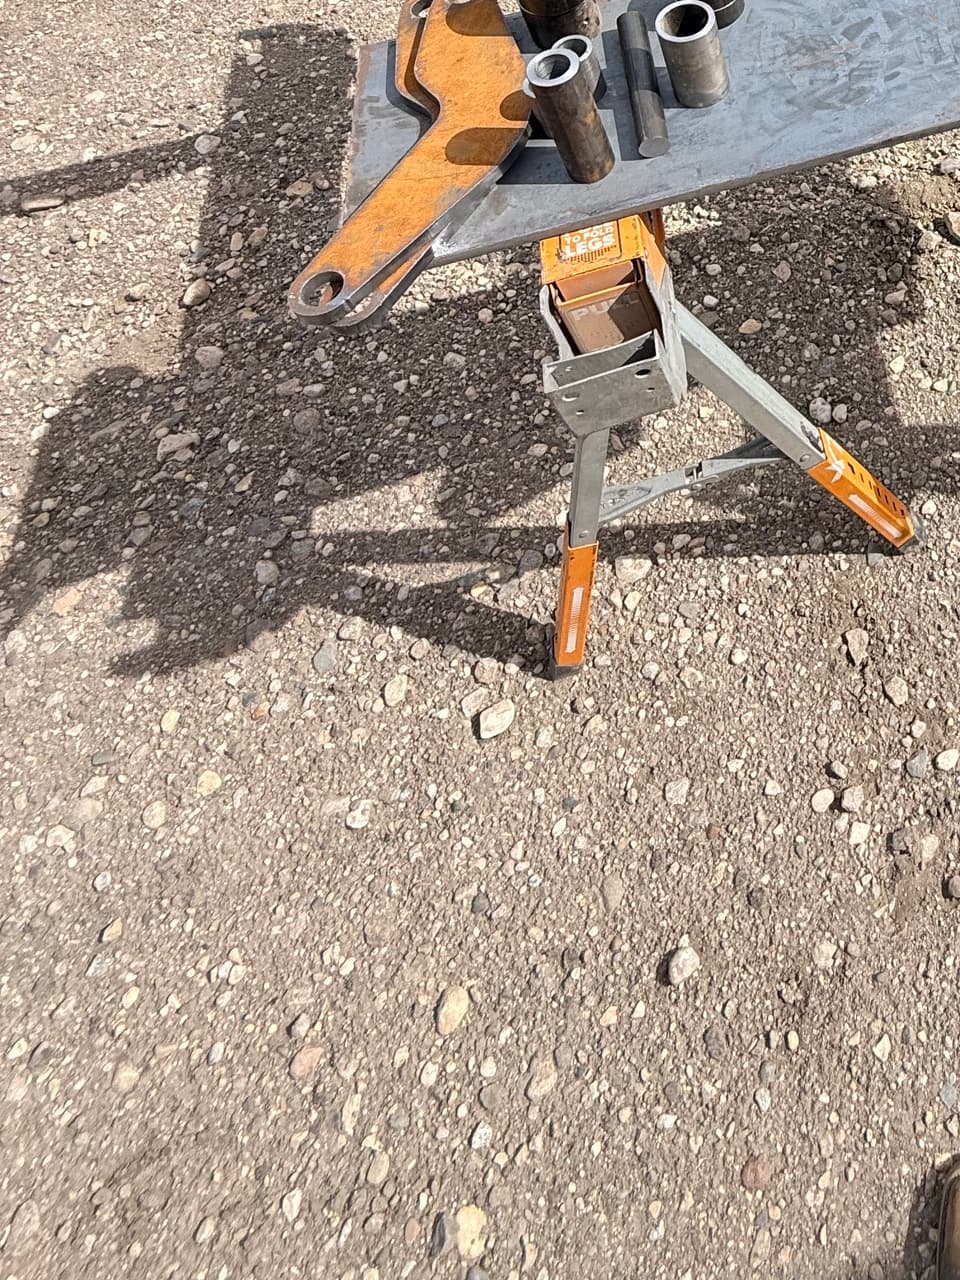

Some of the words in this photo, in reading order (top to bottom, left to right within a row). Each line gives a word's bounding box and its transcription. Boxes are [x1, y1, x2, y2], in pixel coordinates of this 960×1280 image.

[564, 234, 581, 244] TO
[583, 226, 614, 240] FOLD
[564, 233, 616, 258] LEGS
[574, 294, 640, 321] PULL
